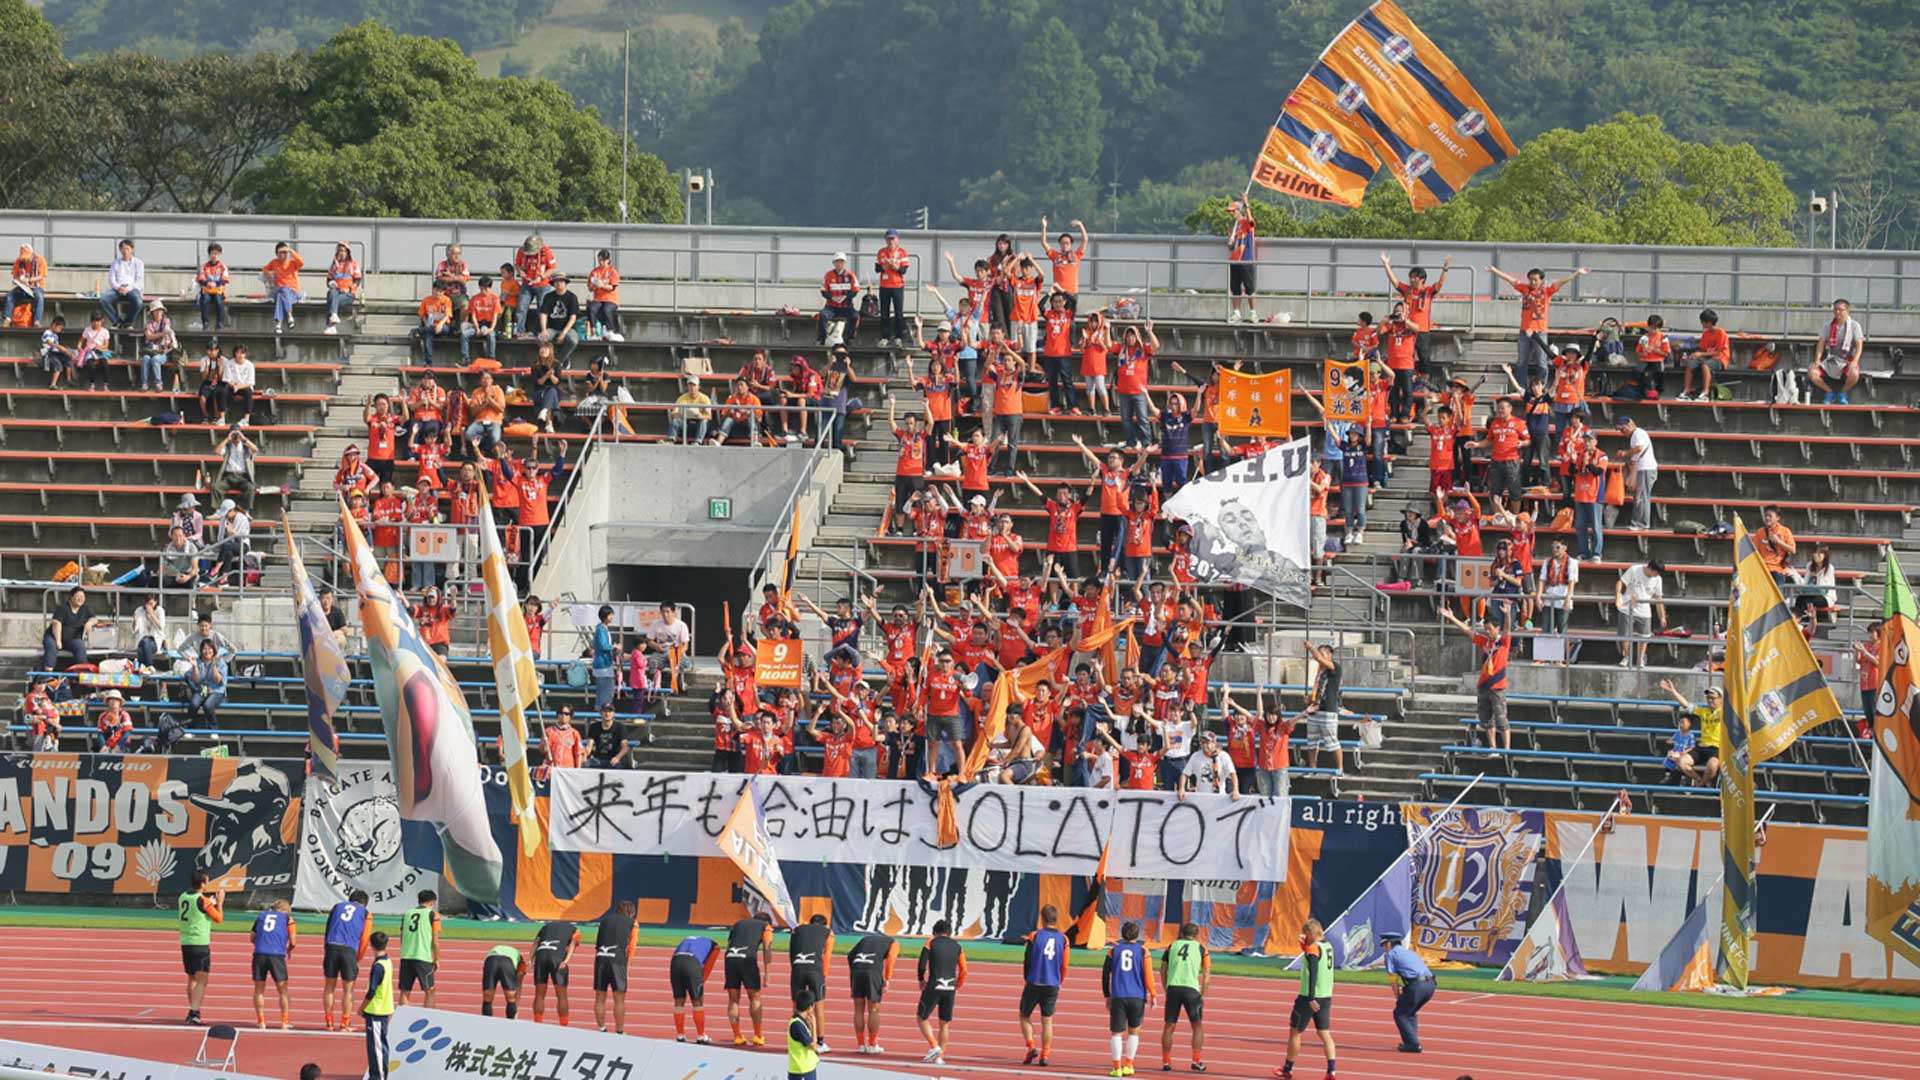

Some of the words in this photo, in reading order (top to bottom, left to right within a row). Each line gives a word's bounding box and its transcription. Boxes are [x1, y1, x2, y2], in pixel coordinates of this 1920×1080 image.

[1330, 368, 1342, 387] 9
[774, 643, 788, 663] 9
[1302, 801, 1333, 824] all
[51, 841, 126, 880] 09
[1437, 850, 1488, 903] 12
[180, 899, 190, 922] 2
[340, 904, 356, 922] 3
[263, 914, 279, 932] 5
[409, 912, 421, 933] 3
[1043, 937, 1056, 960] 4
[1419, 926, 1481, 950] D'Arc
[1120, 948, 1133, 972] 6
[1177, 943, 1190, 961] 4
[1326, 948, 1333, 971] 5
[444, 1041, 634, 1080] 株式会社ユタカ
